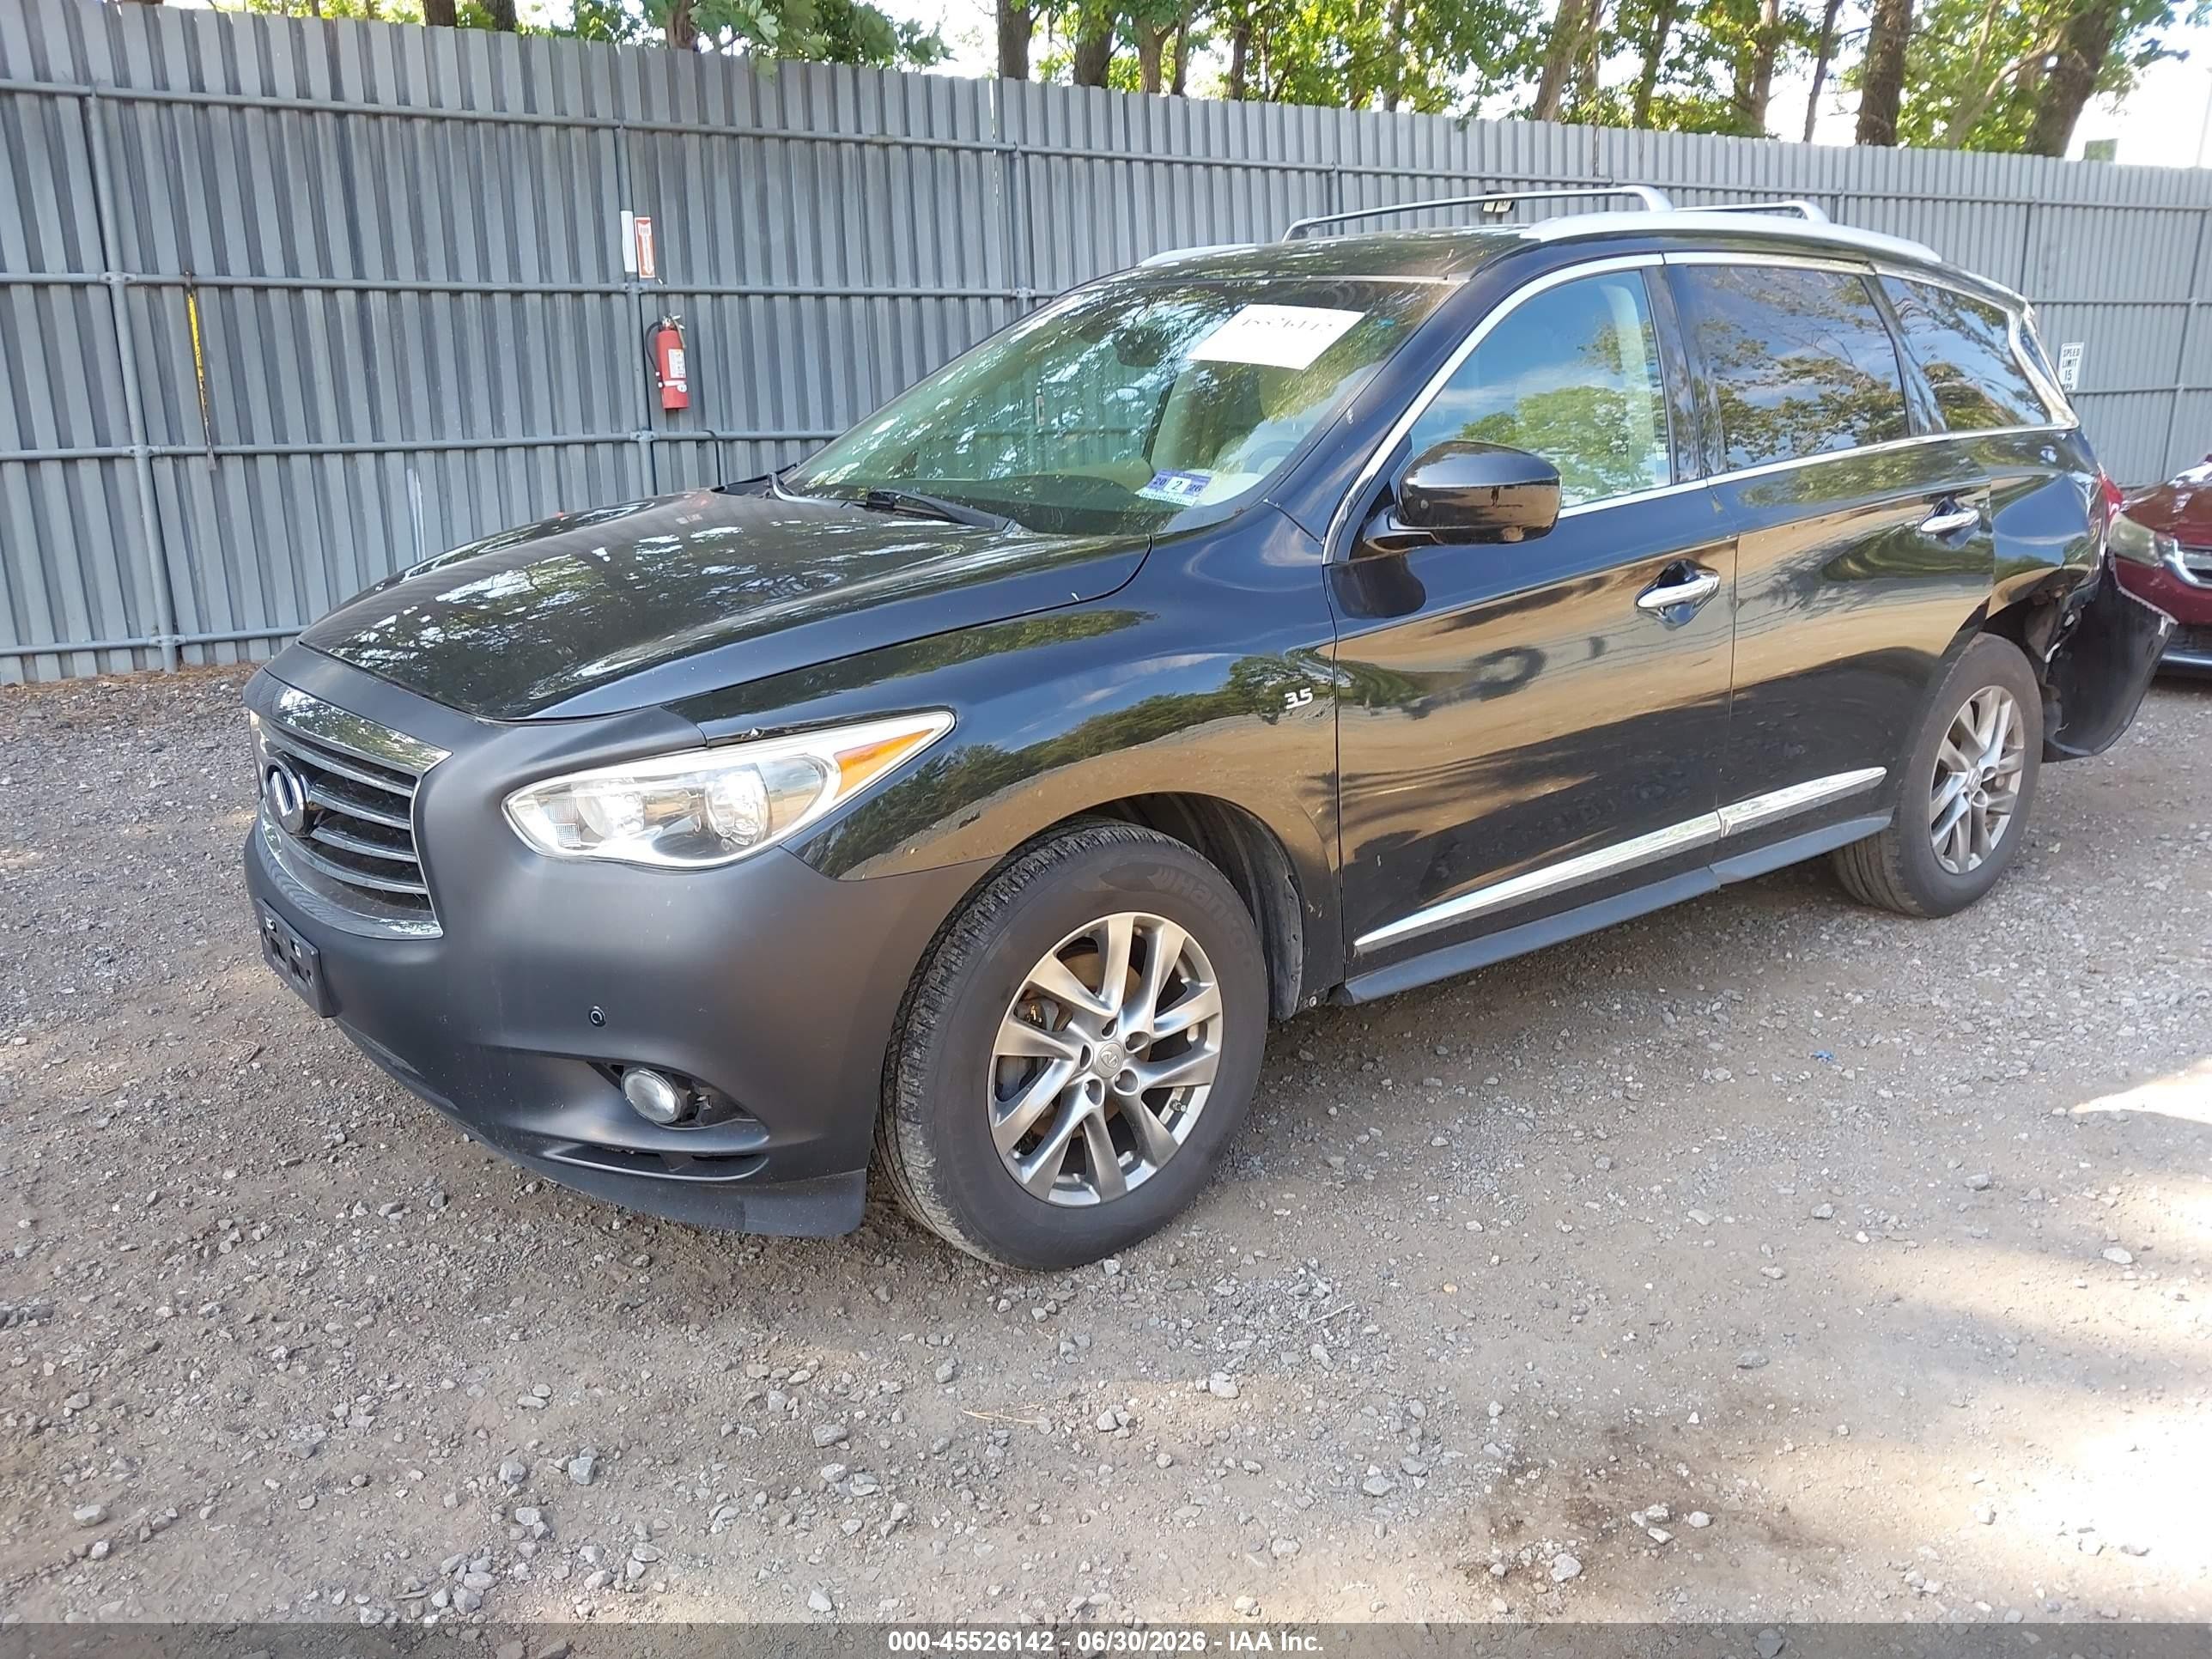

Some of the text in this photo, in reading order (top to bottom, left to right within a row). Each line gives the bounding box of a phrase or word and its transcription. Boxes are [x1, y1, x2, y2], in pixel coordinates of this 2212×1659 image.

[2063, 349, 2080, 357] SPEED
[2062, 358, 2078, 368] LIMIT
[2064, 369, 2072, 380] 15
[1171, 480, 1182, 489] 2
